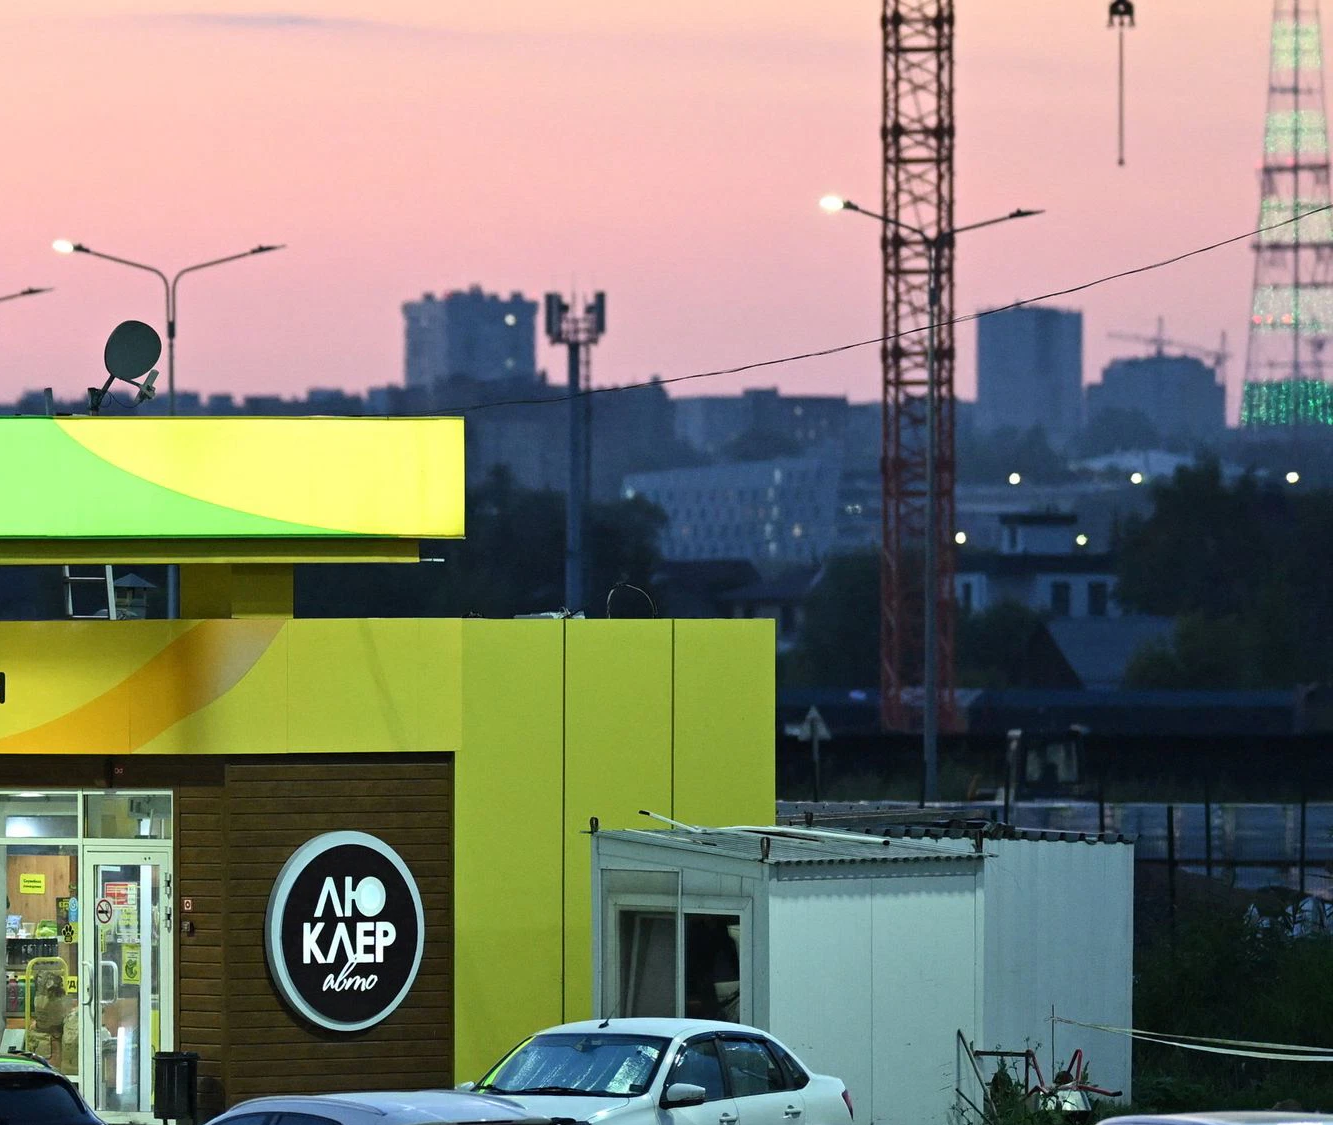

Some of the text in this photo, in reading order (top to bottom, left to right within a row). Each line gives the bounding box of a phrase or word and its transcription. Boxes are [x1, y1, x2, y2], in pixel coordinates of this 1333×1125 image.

[313, 876, 386, 918] ЛЮ
[302, 921, 396, 964] КЛЕР
[322, 956, 378, 992] авто
